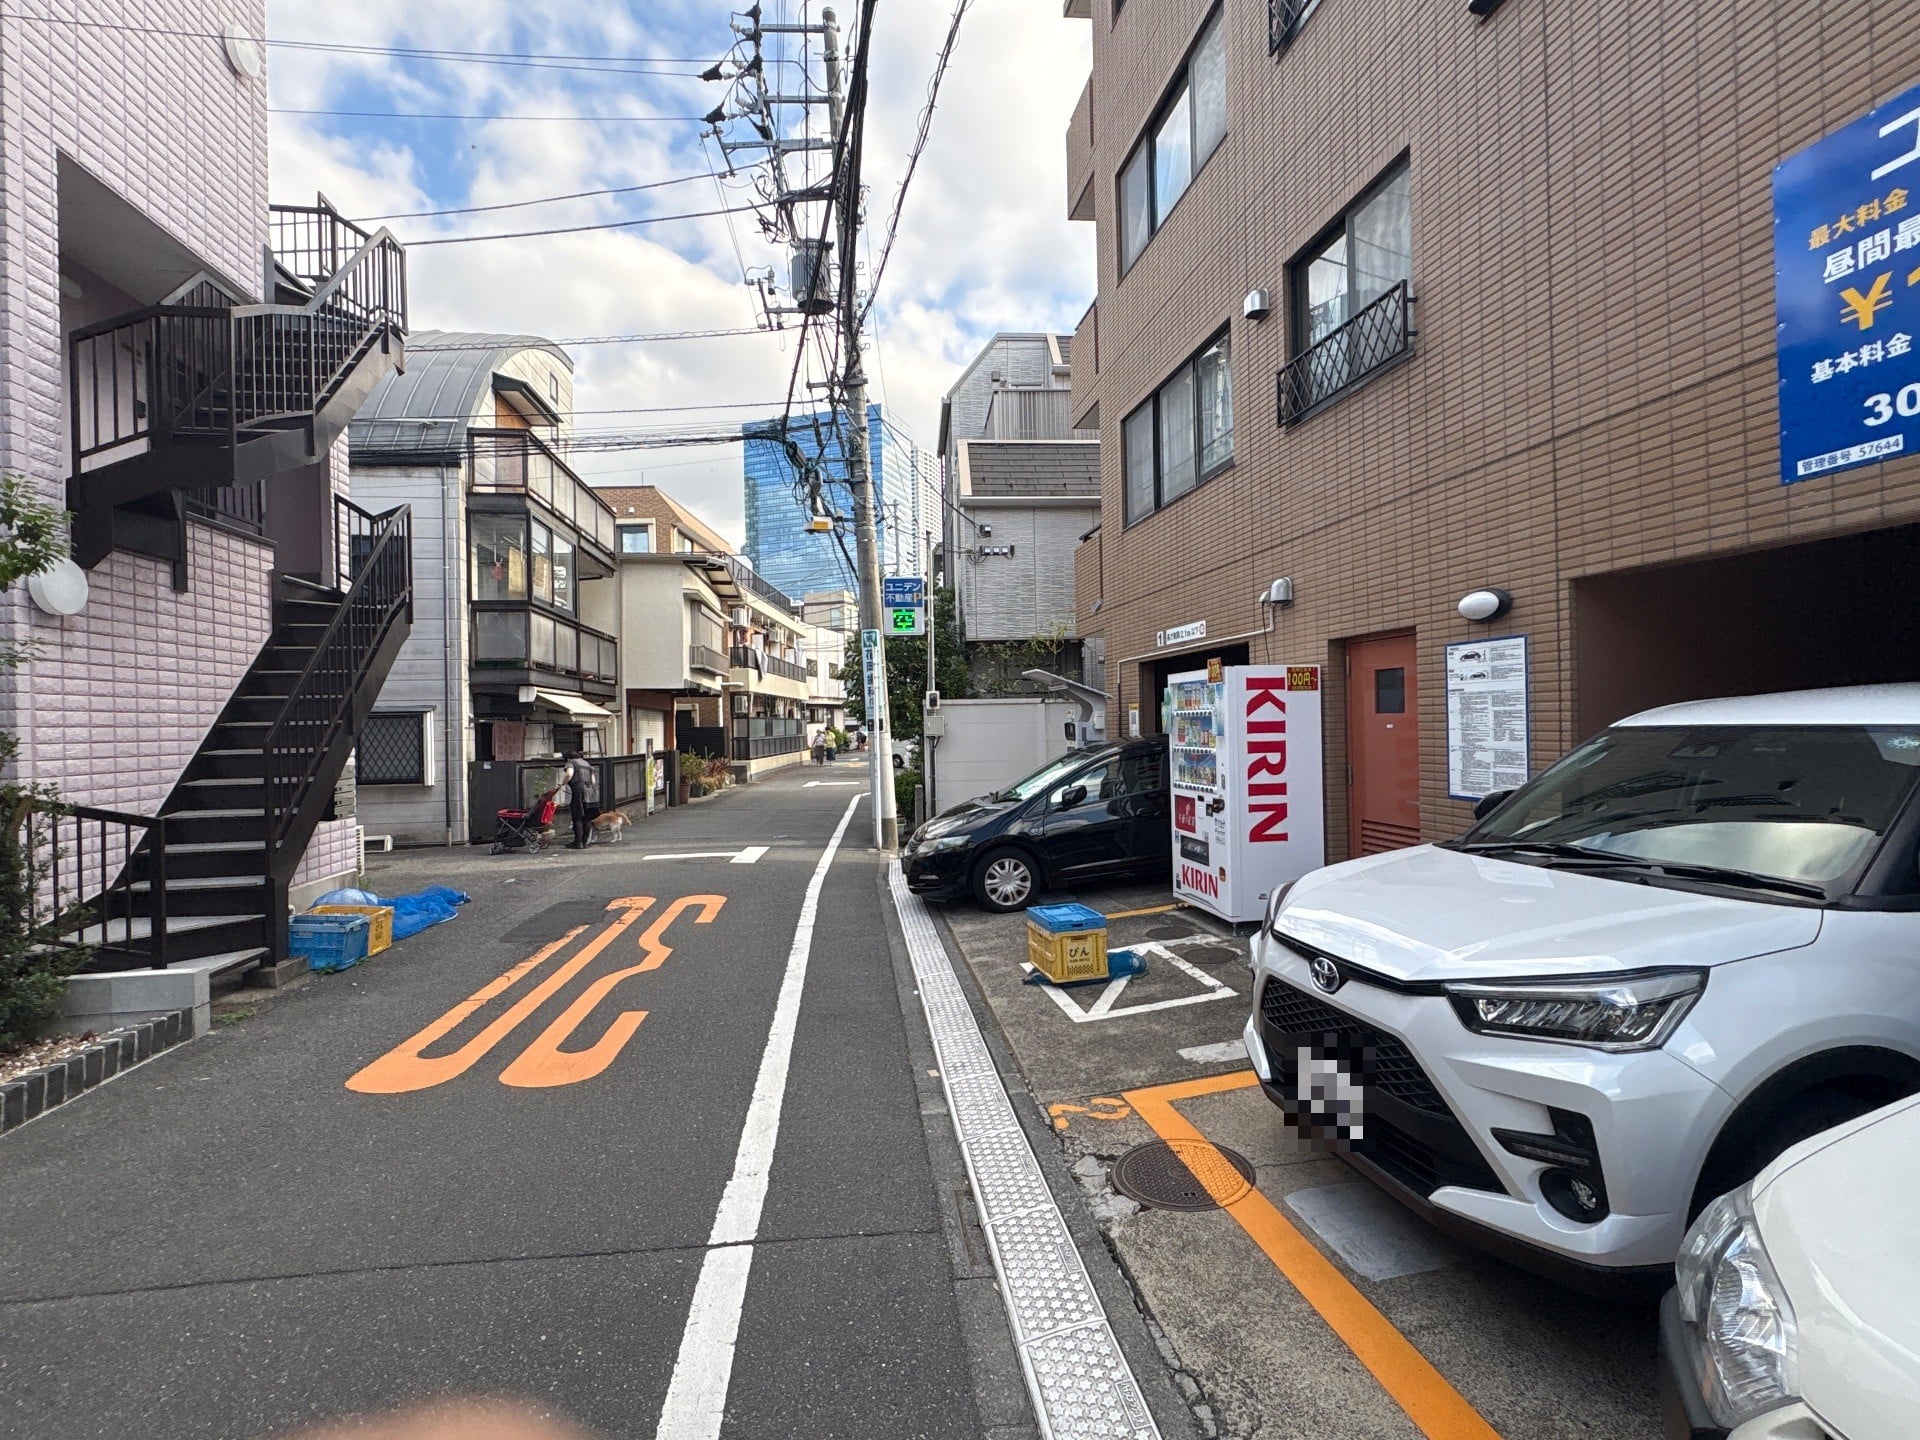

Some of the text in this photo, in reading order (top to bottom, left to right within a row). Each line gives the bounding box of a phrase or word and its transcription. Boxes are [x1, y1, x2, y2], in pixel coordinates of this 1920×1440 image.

[1807, 187, 1910, 251] 最大料金
[1823, 213, 1920, 284] 昼間最
[1810, 332, 1913, 384] 基本料金
[1801, 438, 1901, 472] 管理番号 57644
[886, 582, 921, 592] ユニデン
[893, 609, 916, 633] 空
[1245, 676, 1289, 843] KIRIN
[1181, 863, 1219, 900] KIRIN
[1069, 946, 1090, 958] びん
